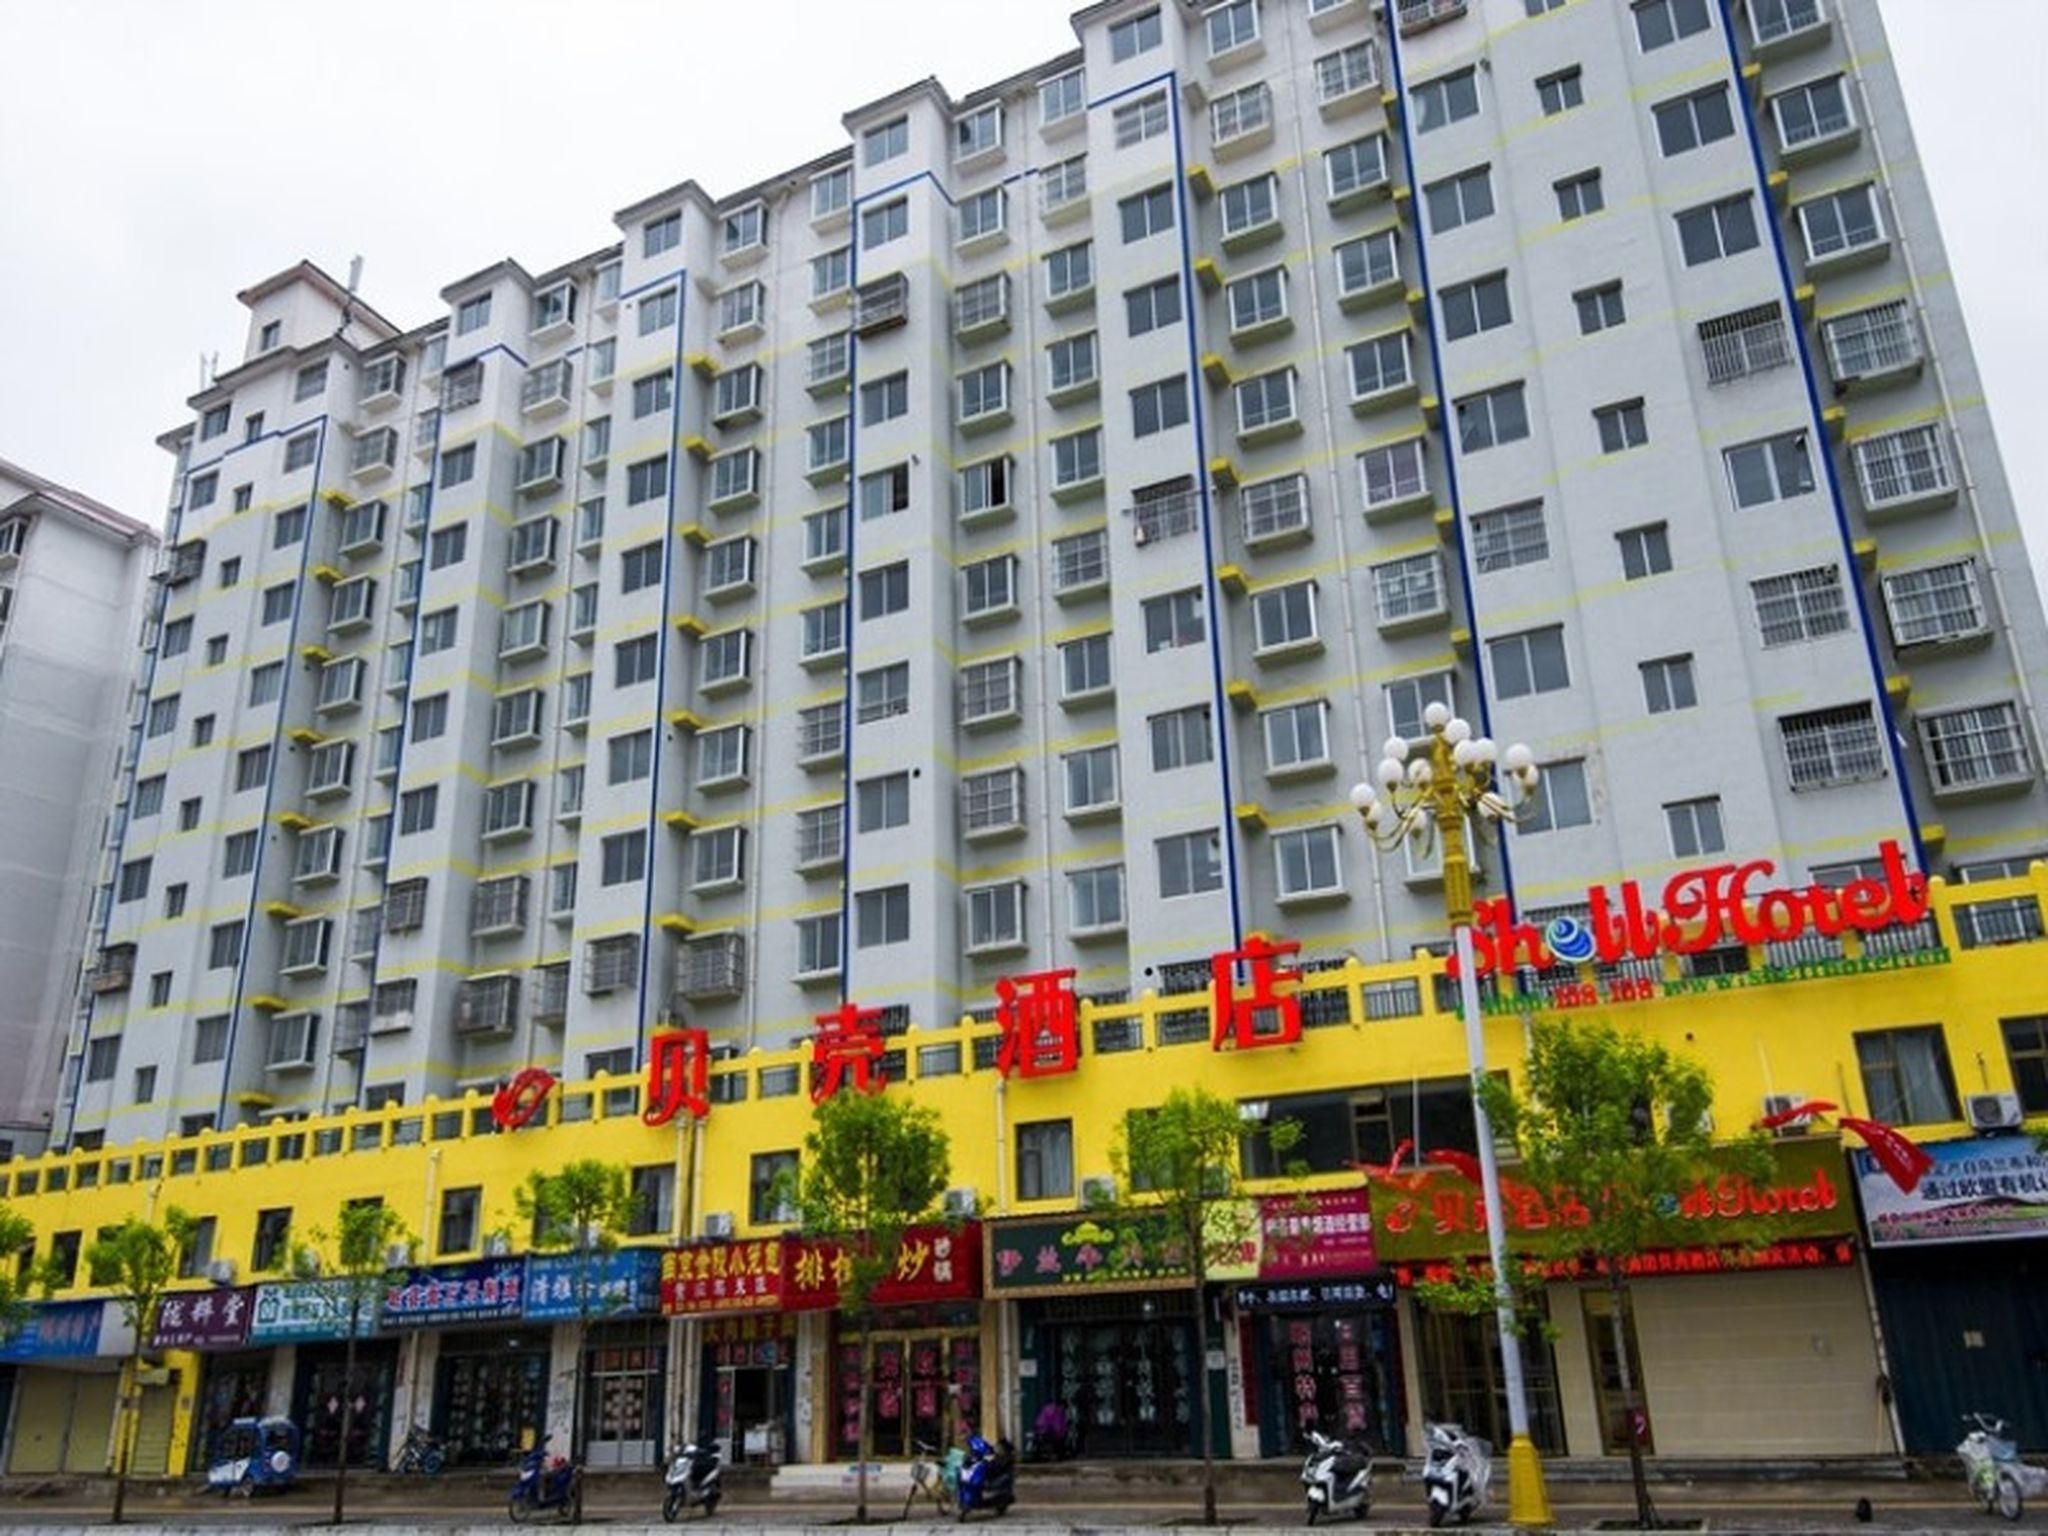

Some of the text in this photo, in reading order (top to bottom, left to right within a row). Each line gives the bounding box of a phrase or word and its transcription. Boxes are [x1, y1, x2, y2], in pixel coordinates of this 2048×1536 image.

[1662, 840, 1930, 955] Hotel
[643, 934, 1303, 1127] 贝壳酒店
